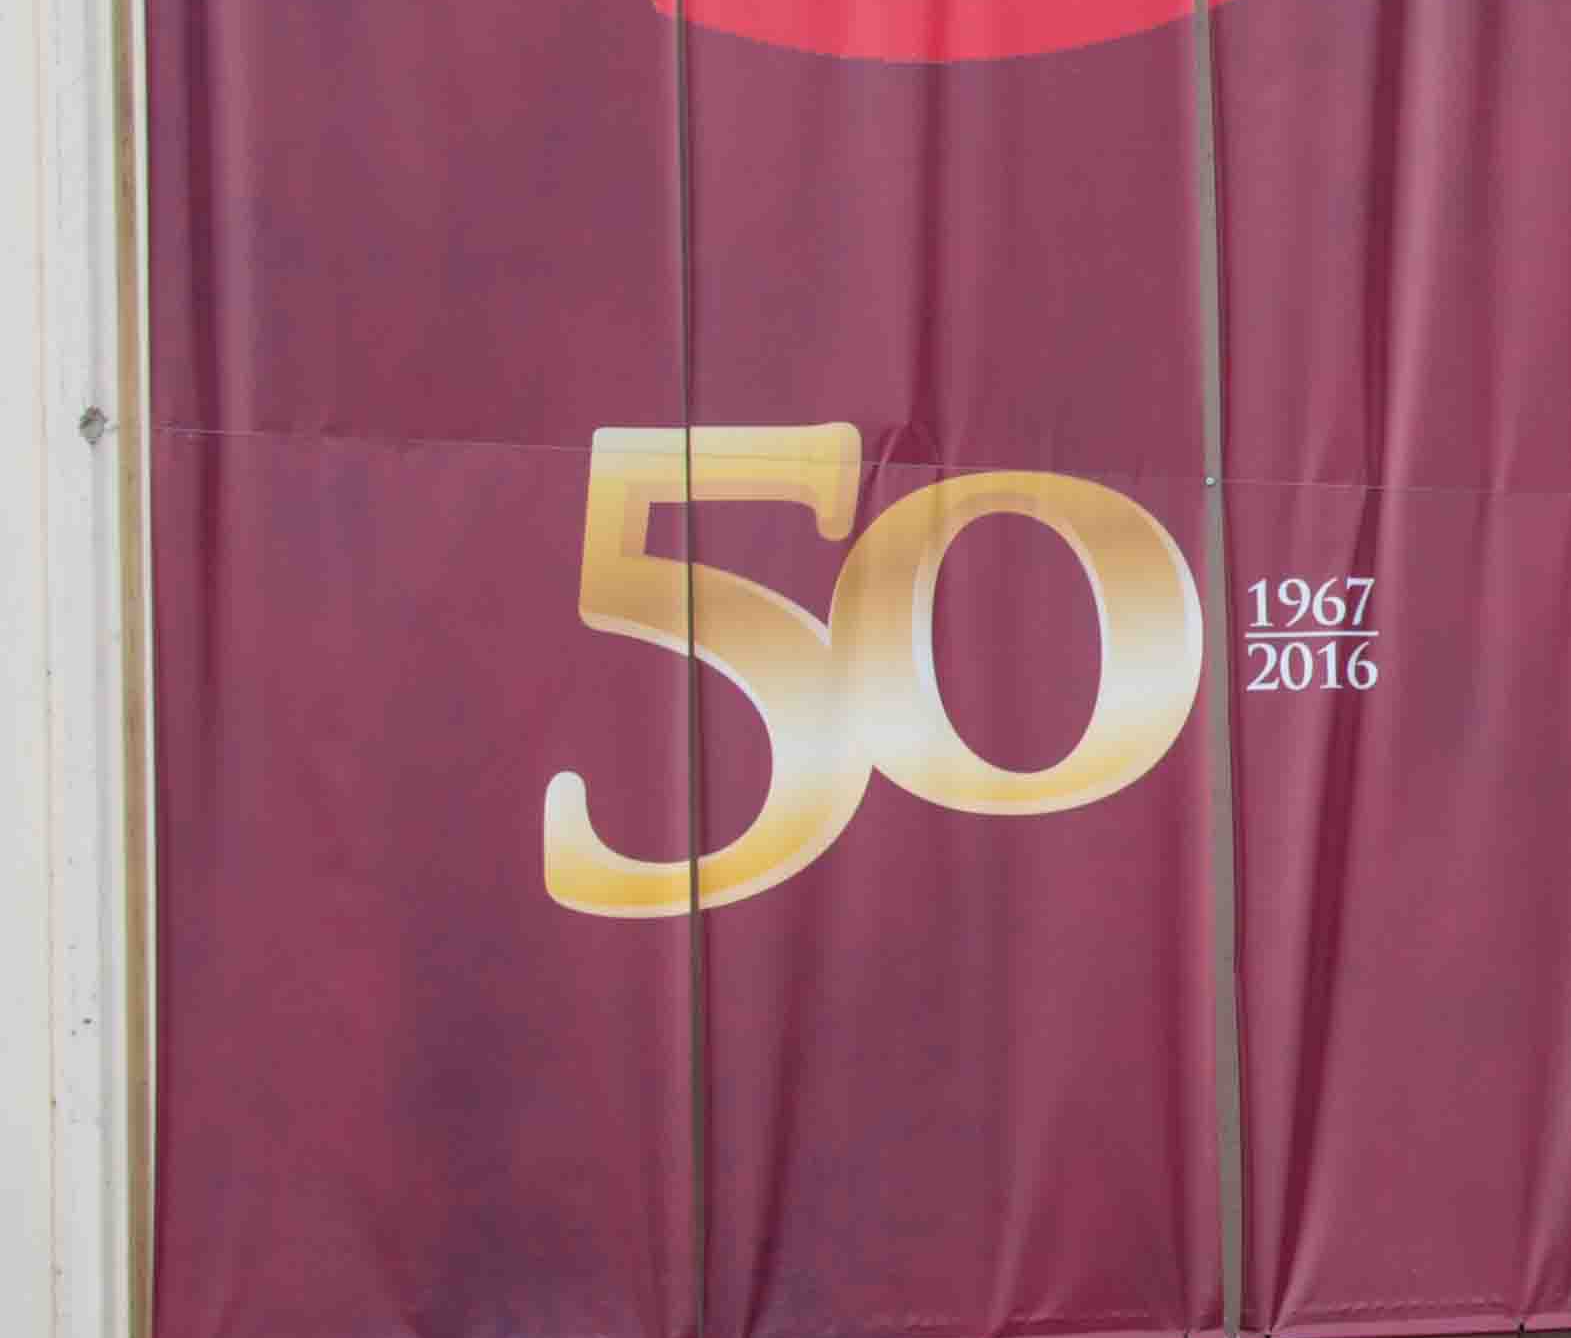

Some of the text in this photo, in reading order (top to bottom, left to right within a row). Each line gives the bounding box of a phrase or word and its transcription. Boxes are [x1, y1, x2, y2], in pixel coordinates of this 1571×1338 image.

[1246, 576, 1375, 629] 1967
[544, 421, 1203, 919] 50
[1245, 641, 1379, 692] 2016
